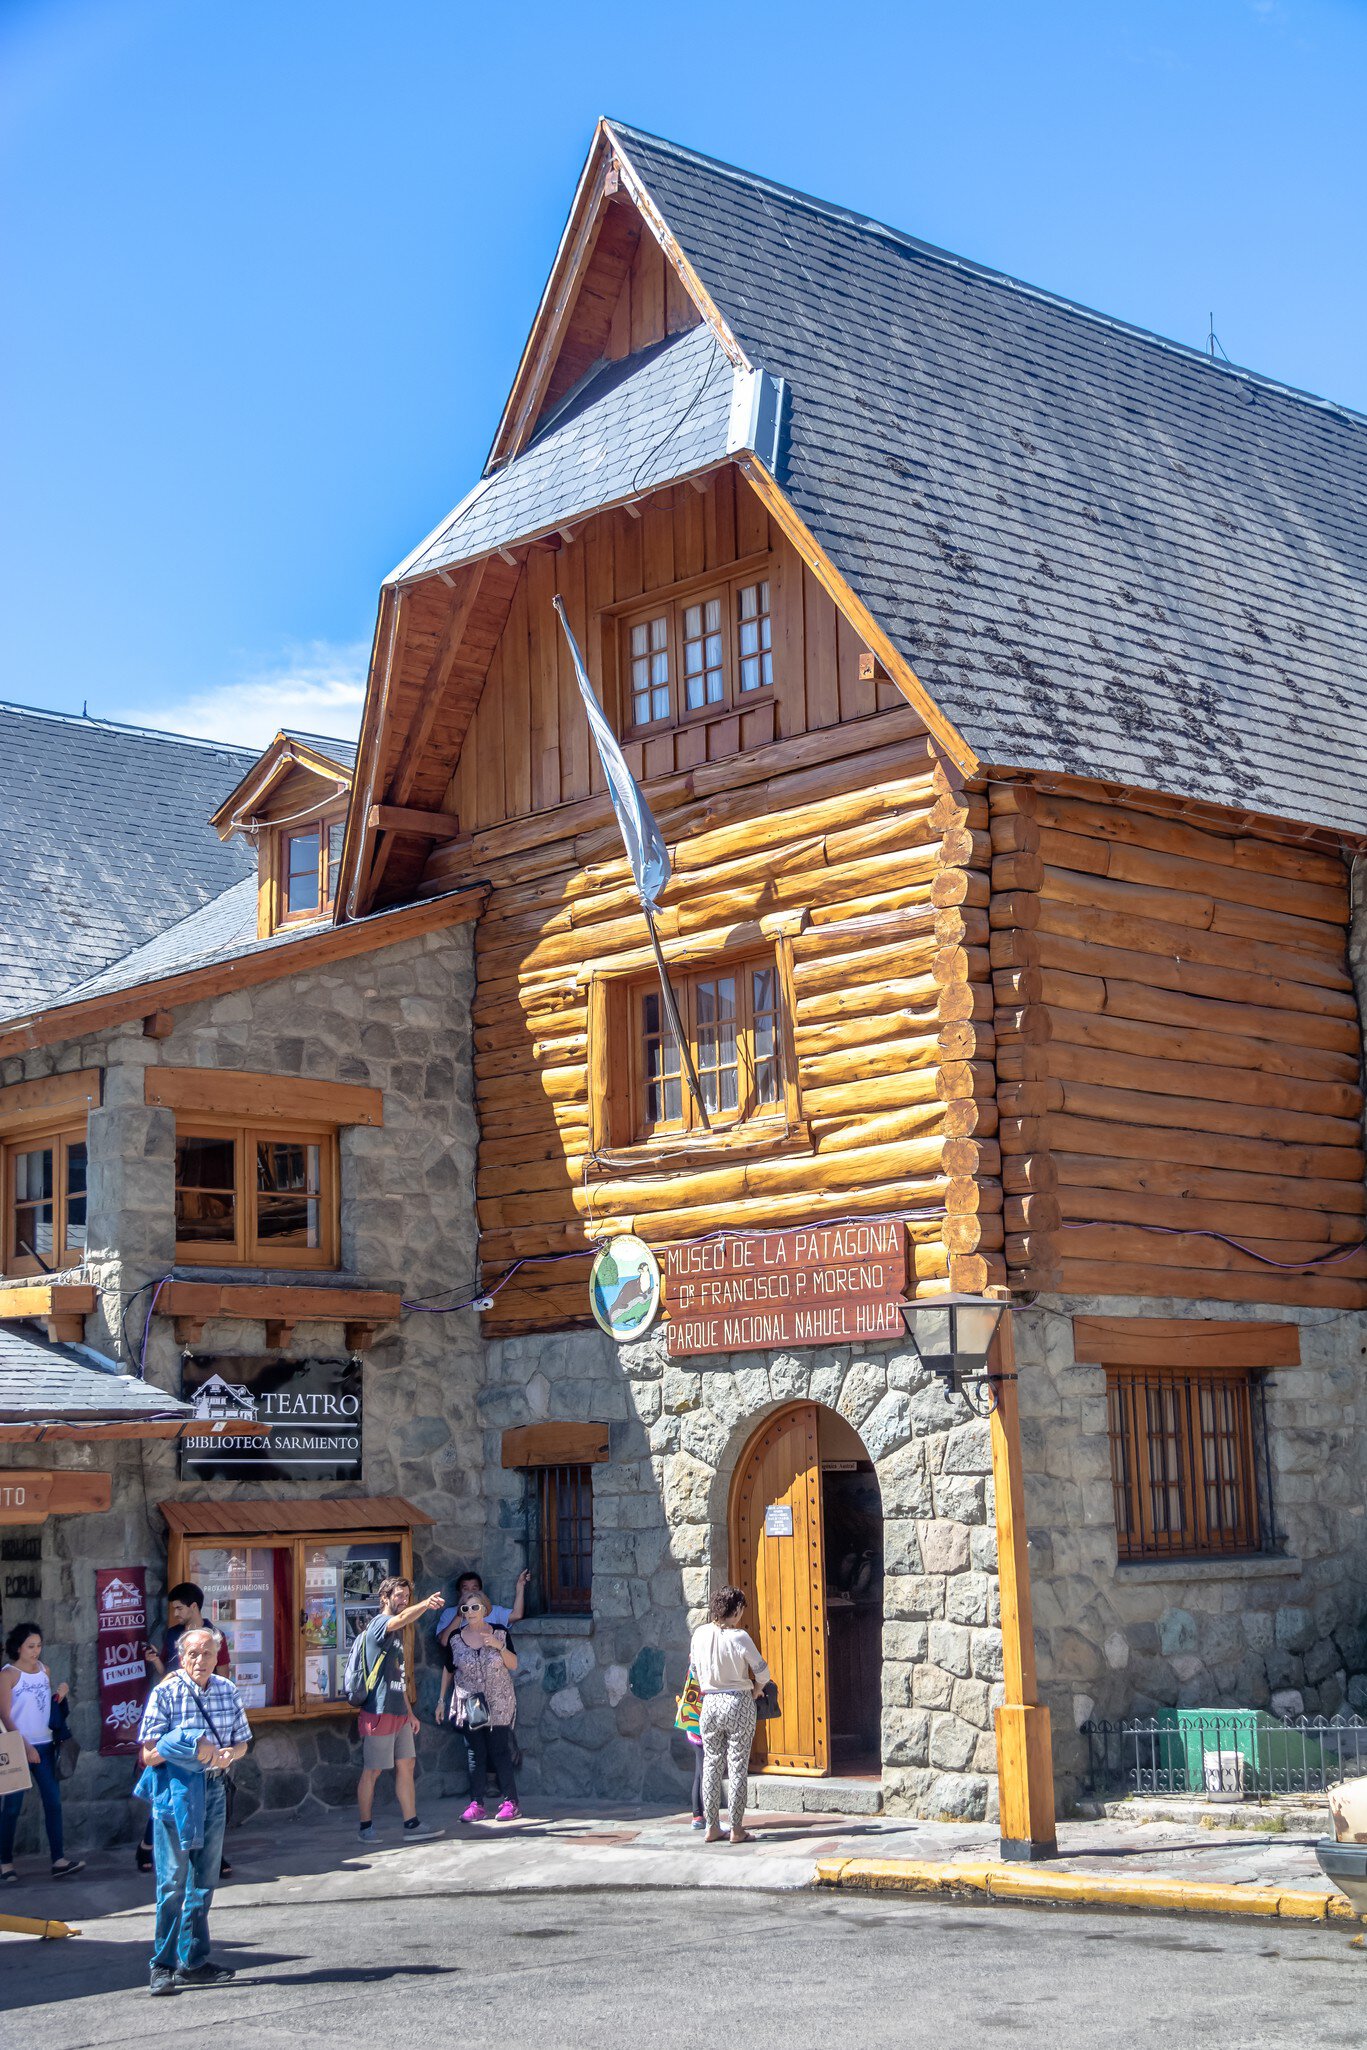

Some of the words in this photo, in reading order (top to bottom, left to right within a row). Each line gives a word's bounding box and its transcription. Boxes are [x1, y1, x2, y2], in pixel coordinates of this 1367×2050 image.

[668, 1244, 725, 1276] MUSEO
[732, 1240, 755, 1268] DE
[763, 1237, 787, 1264] LA
[795, 1224, 899, 1261] PATAGONIA
[701, 1274, 790, 1306] FRANCISCO
[796, 1272, 807, 1296] P.
[813, 1264, 884, 1294] MORENO
[668, 1320, 719, 1350] PARQUE
[724, 1313, 790, 1345] NACIONAL
[795, 1306, 851, 1339] NAHUEL
[856, 1302, 899, 1333] HUAPI
[261, 1393, 359, 1416] TEATRO
[186, 1435, 272, 1449] BIBLIOTECA
[275, 1436, 359, 1450] SARMIENTO
[0, 1487, 26, 1506] TO
[235, 1583, 269, 1591] FUNCIONES
[100, 1614, 145, 1628] TEATRO
[104, 1641, 139, 1666] HOY
